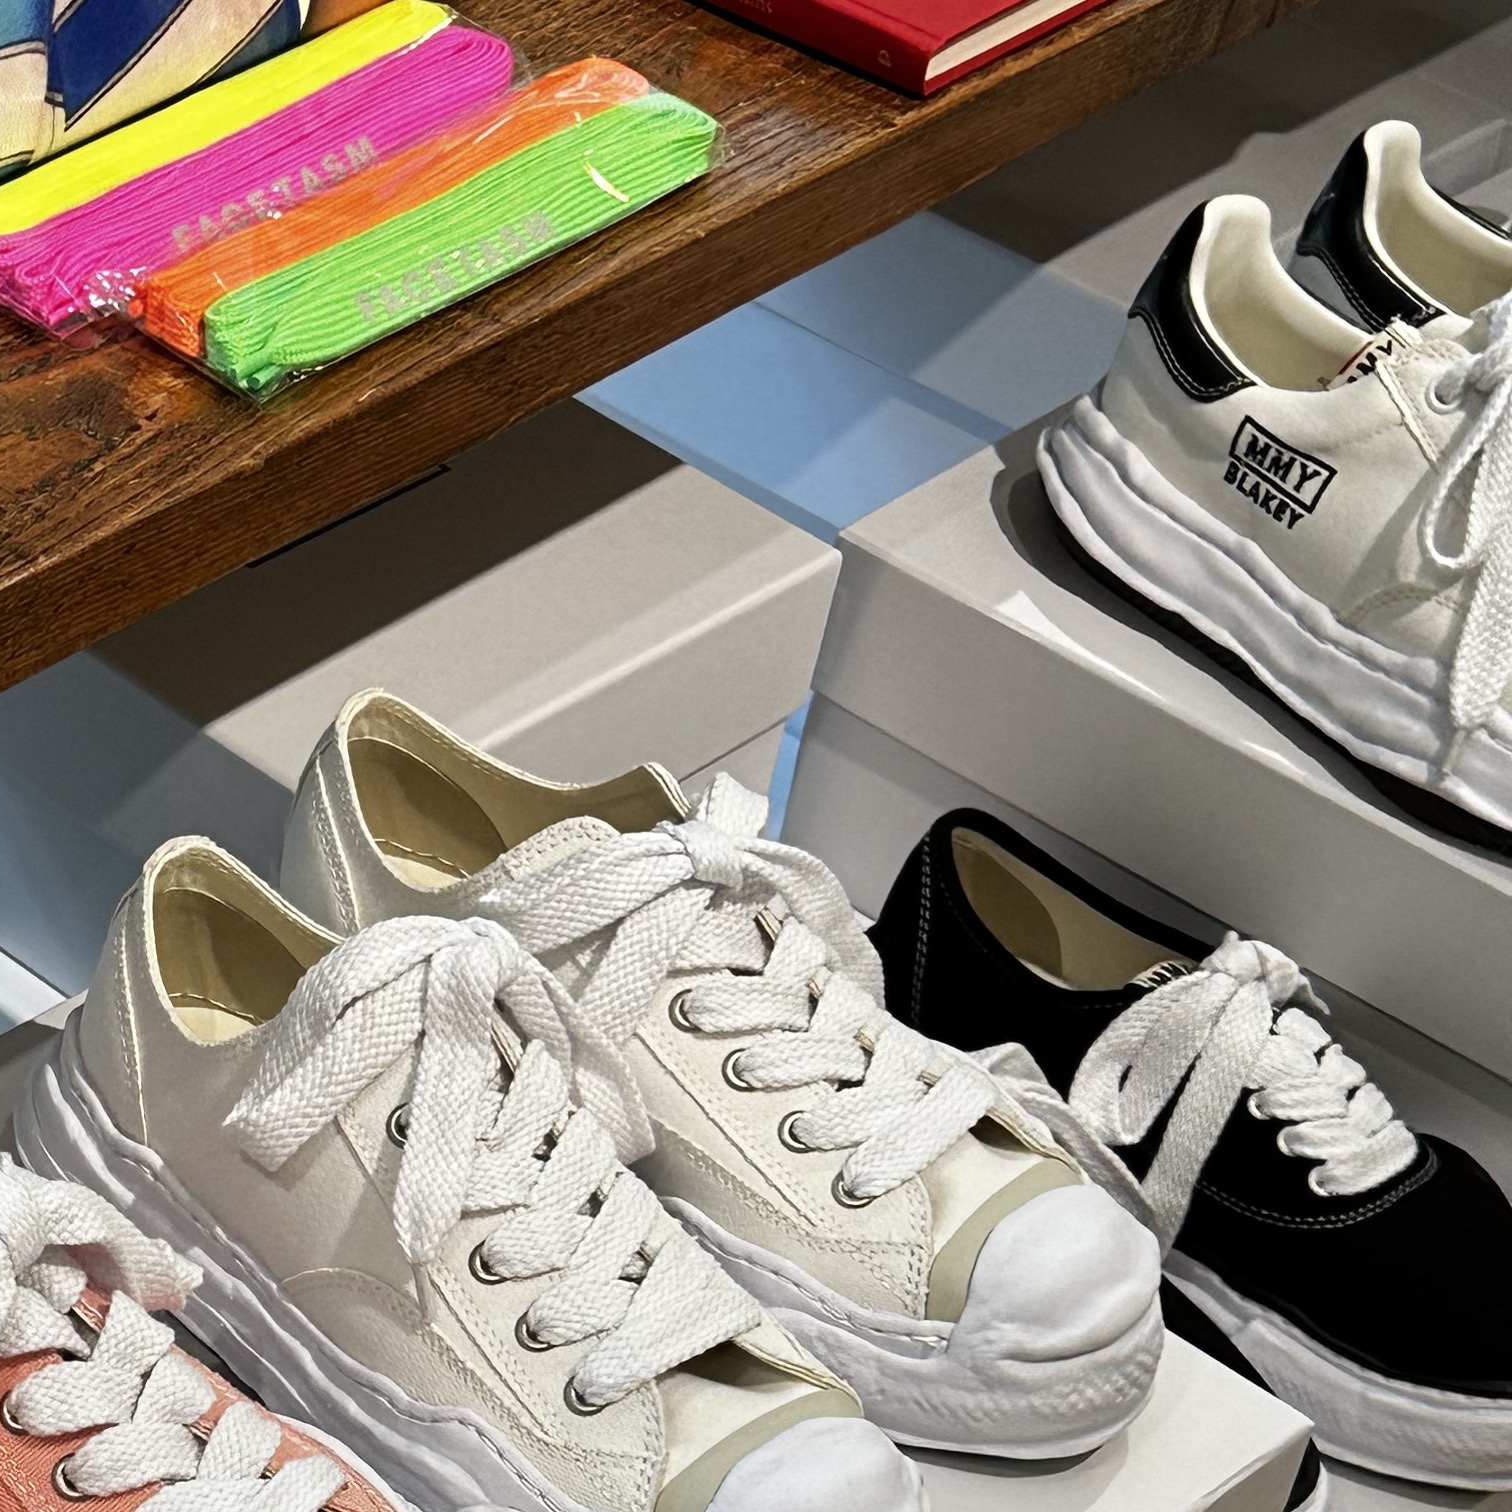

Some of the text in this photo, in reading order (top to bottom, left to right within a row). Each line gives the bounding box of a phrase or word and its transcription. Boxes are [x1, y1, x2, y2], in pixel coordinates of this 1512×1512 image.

[170, 135, 379, 254] FACETASM
[354, 209, 555, 324] FACETASM
[1223, 460, 1305, 530] BLAKEY
[1243, 432, 1323, 494] MMY
